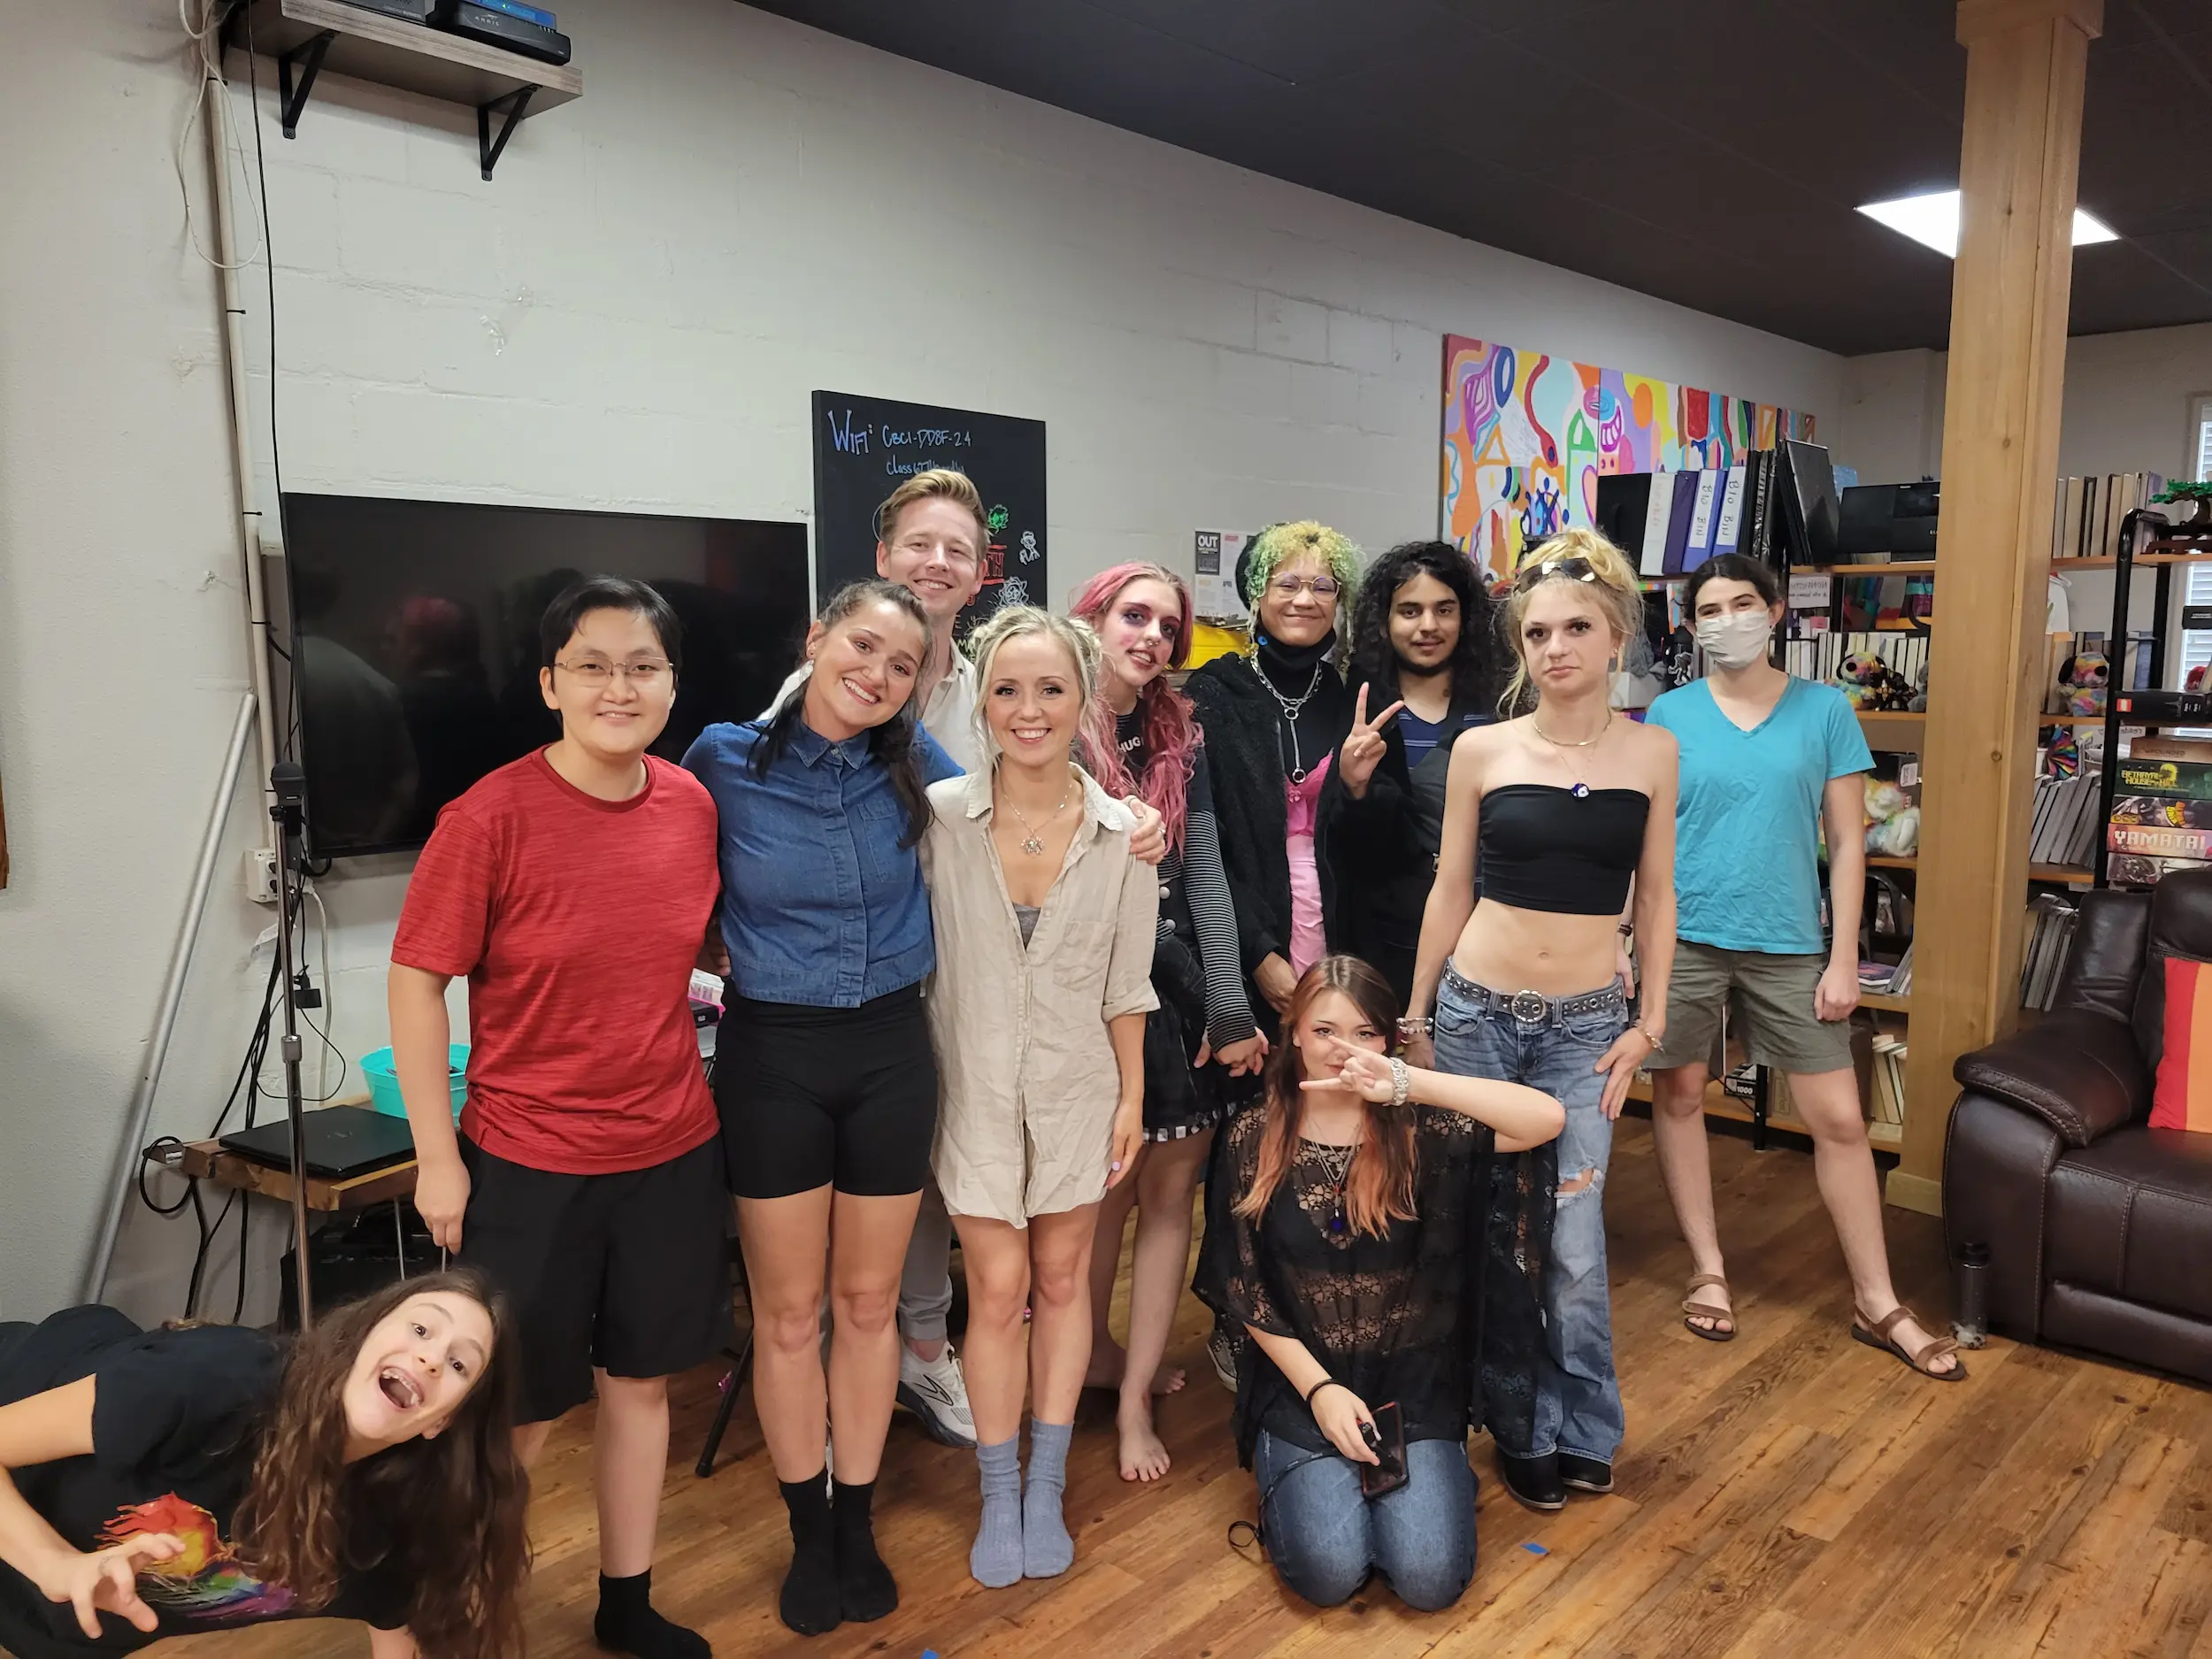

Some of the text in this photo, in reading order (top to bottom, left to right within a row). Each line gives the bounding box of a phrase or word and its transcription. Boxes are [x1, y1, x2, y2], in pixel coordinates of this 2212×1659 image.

[474, 16, 500, 27] ARRIS
[1197, 534, 1218, 548] OUT
[2114, 830, 2206, 850] YAMATAI
[1736, 1086, 1754, 1095] 1000
